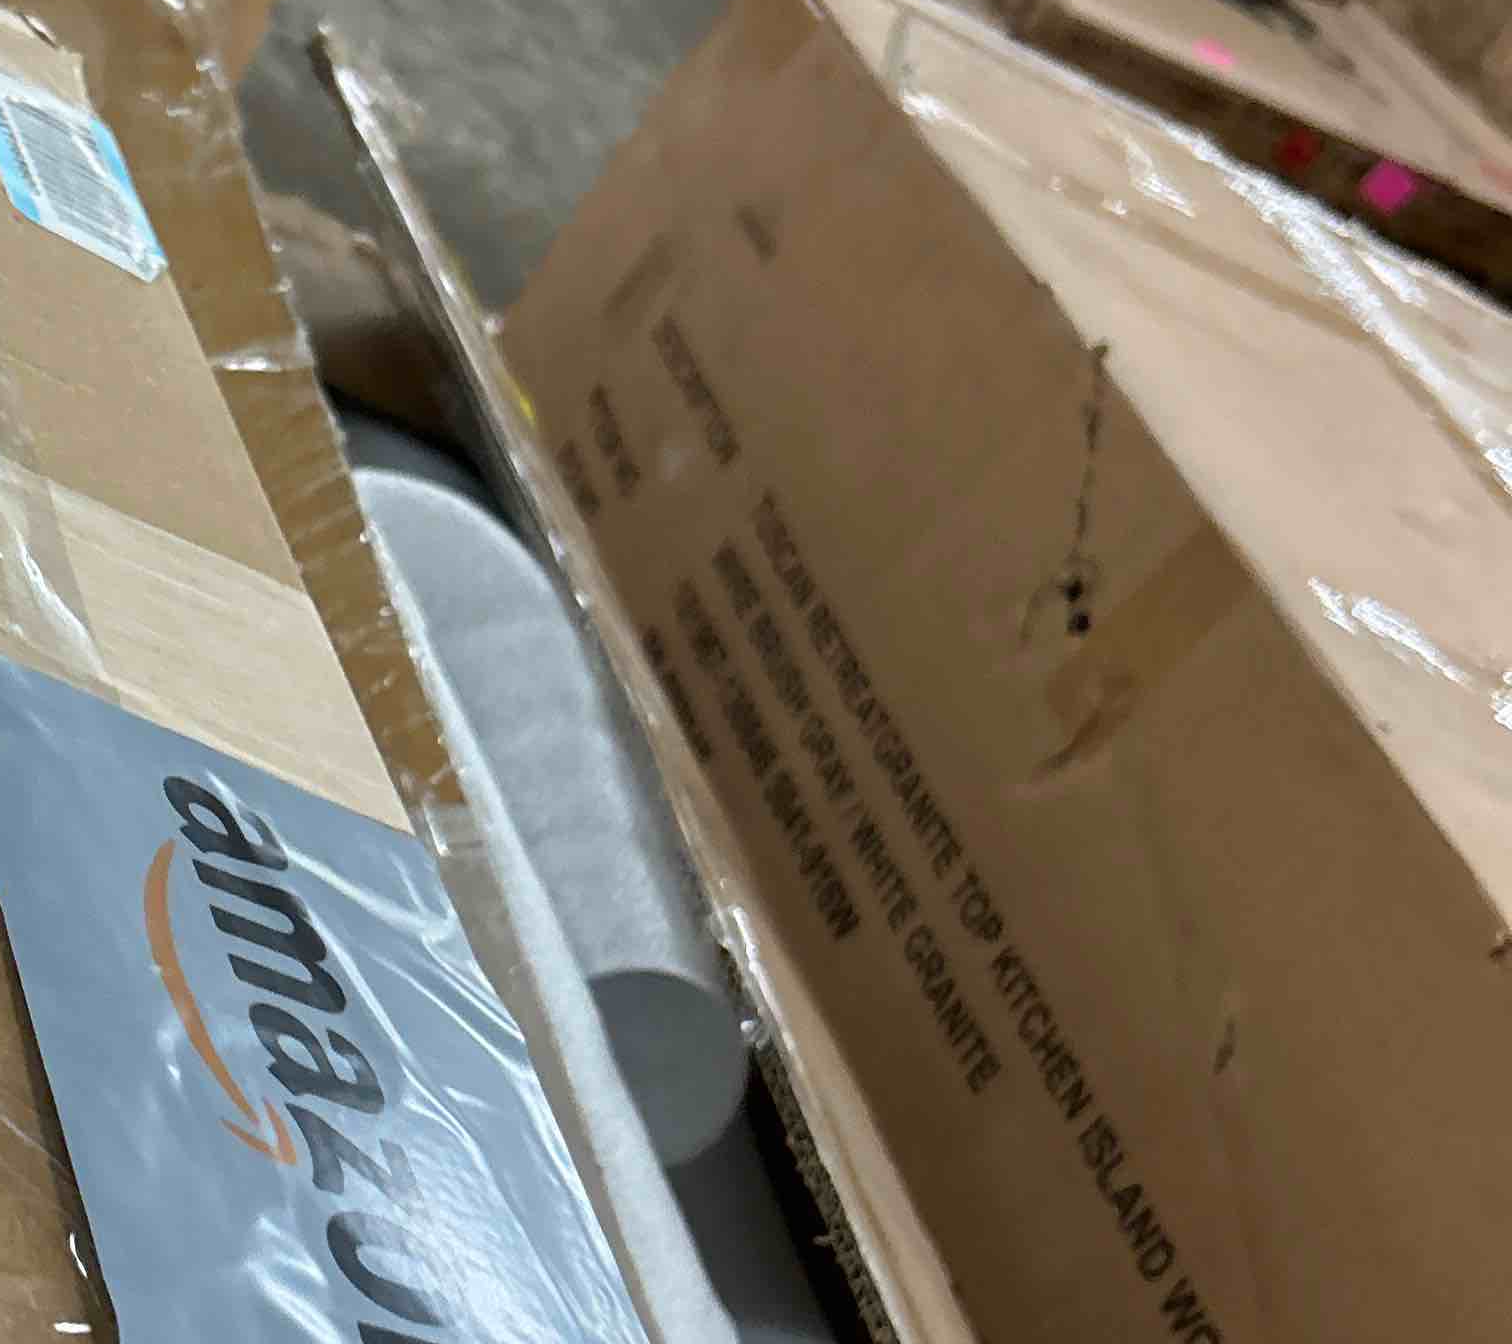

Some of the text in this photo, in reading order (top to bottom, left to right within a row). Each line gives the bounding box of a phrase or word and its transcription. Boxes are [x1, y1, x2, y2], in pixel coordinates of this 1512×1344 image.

[798, 710, 853, 809] GRAY
[848, 811, 909, 935] WHITE
[904, 924, 1002, 1098] GRANITE
[951, 861, 1004, 947] TOP
[990, 944, 1095, 1122] KITCHEN
[1078, 1112, 1175, 1283] ISLAND
